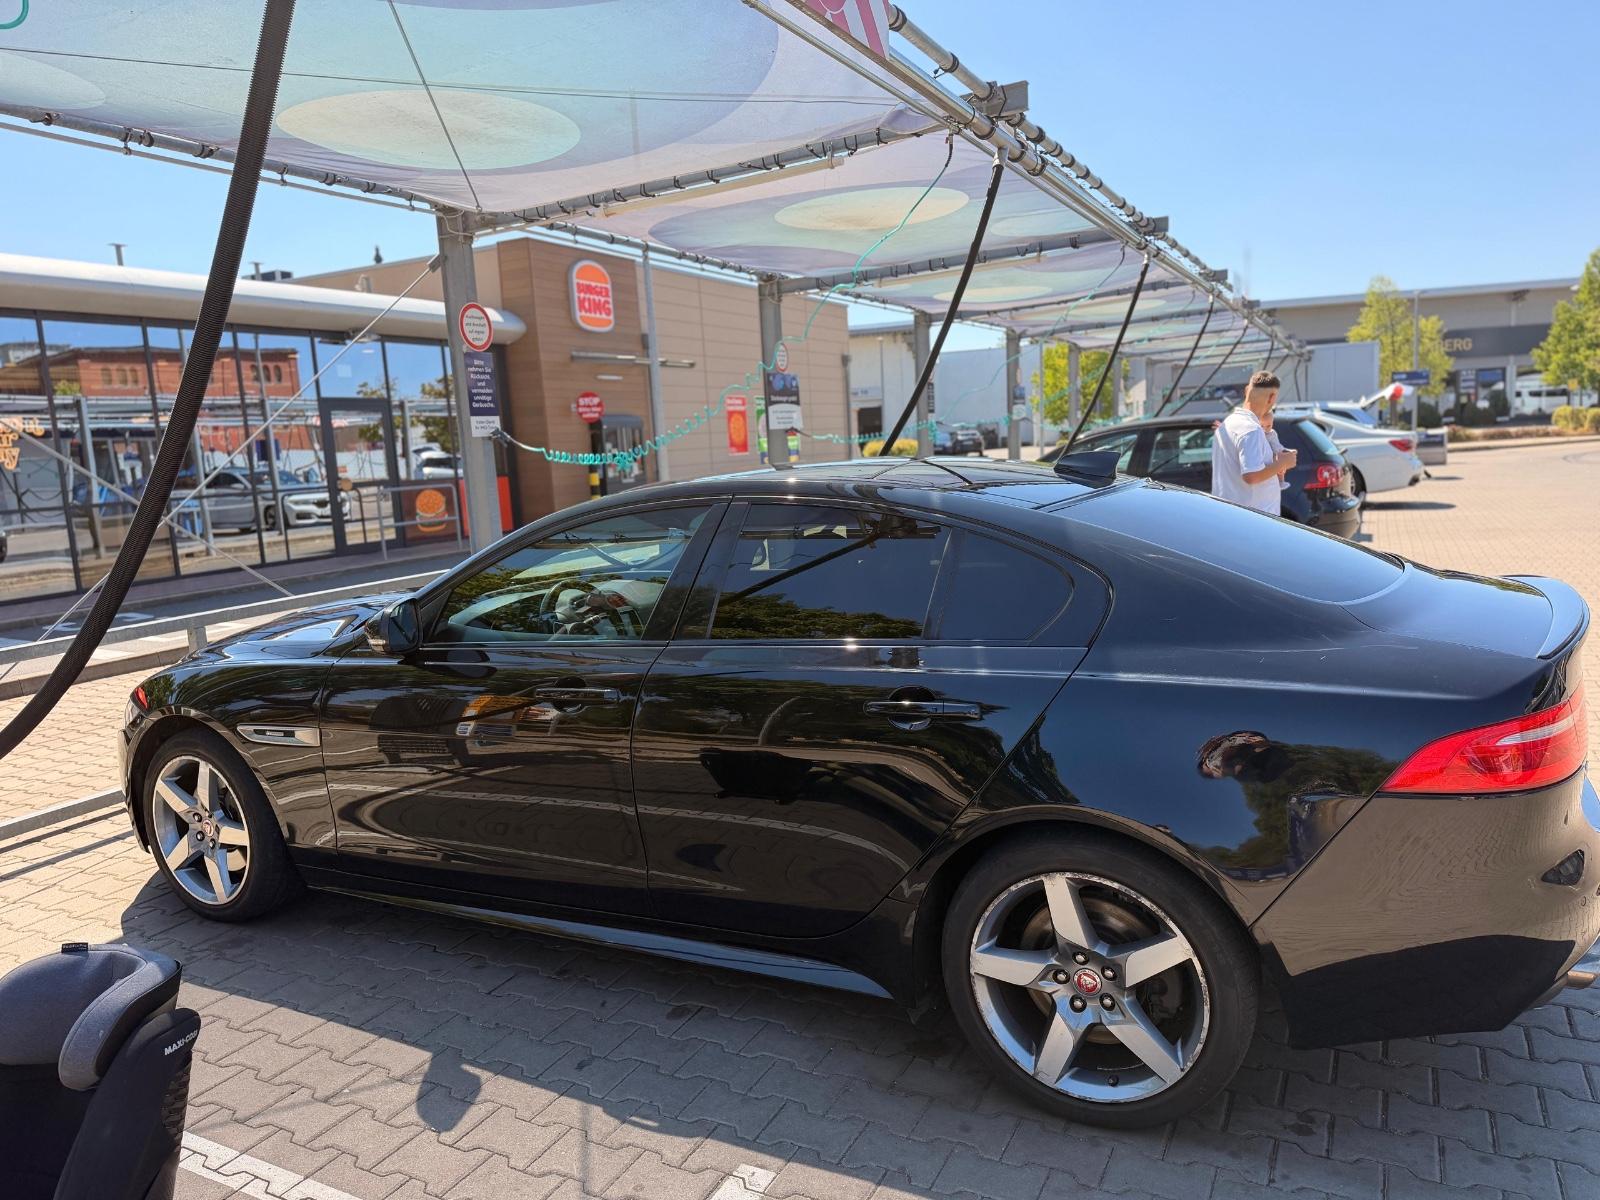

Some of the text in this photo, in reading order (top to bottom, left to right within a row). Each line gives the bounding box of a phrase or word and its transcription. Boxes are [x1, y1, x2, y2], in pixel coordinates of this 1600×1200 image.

[576, 282, 610, 298] BURGER
[577, 296, 612, 317] KING
[578, 397, 601, 406] STOP
